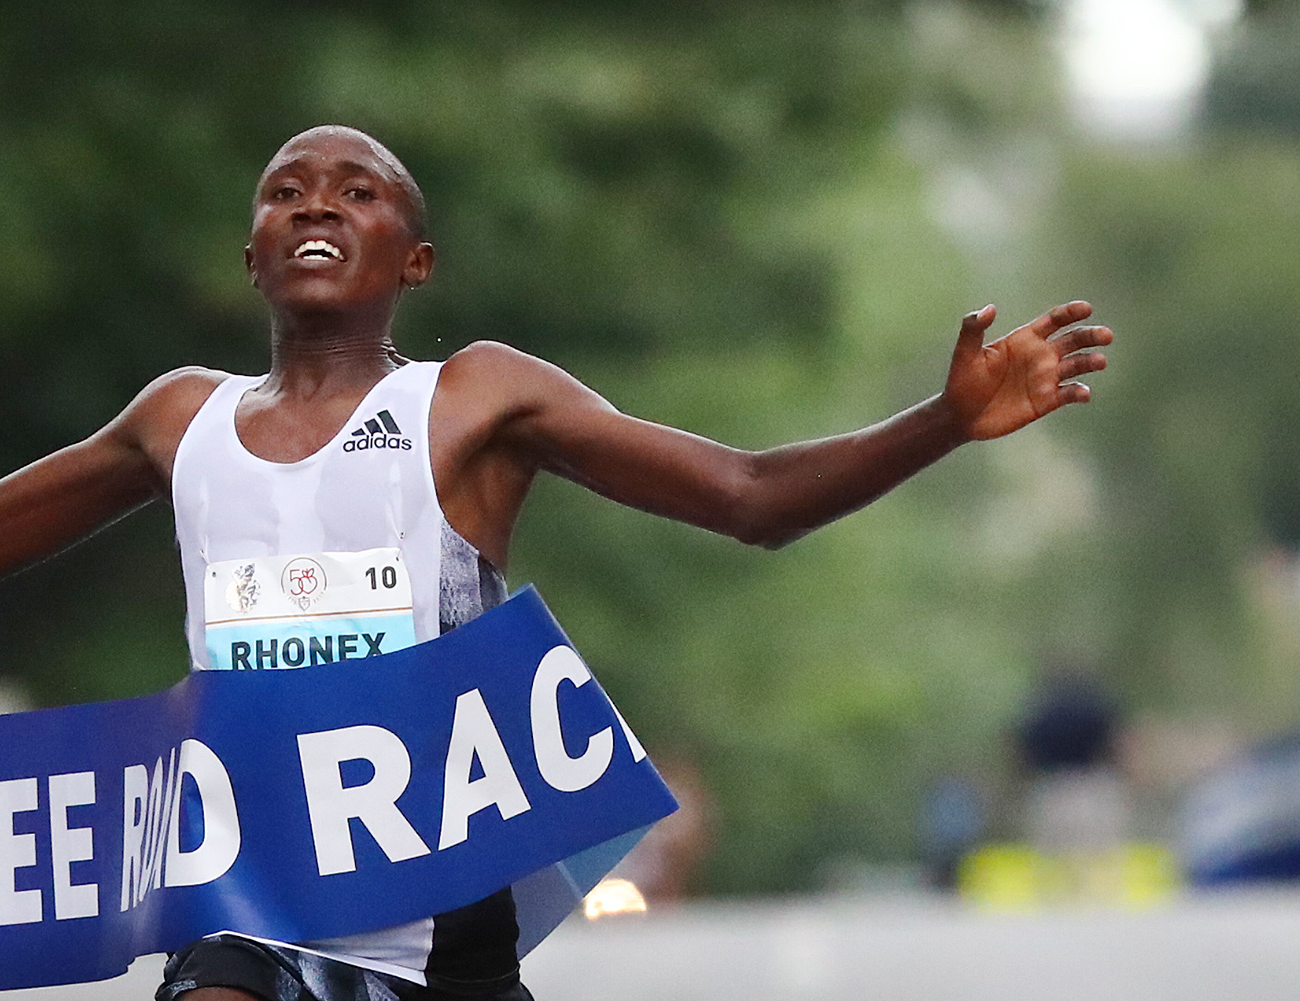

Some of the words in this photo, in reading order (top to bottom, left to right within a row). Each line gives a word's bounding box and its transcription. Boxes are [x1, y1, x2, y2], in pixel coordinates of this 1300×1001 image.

[342, 433, 412, 453] adidas
[365, 566, 398, 590] 10
[231, 632, 386, 670] RHONEX
[296, 644, 648, 876] RAC
